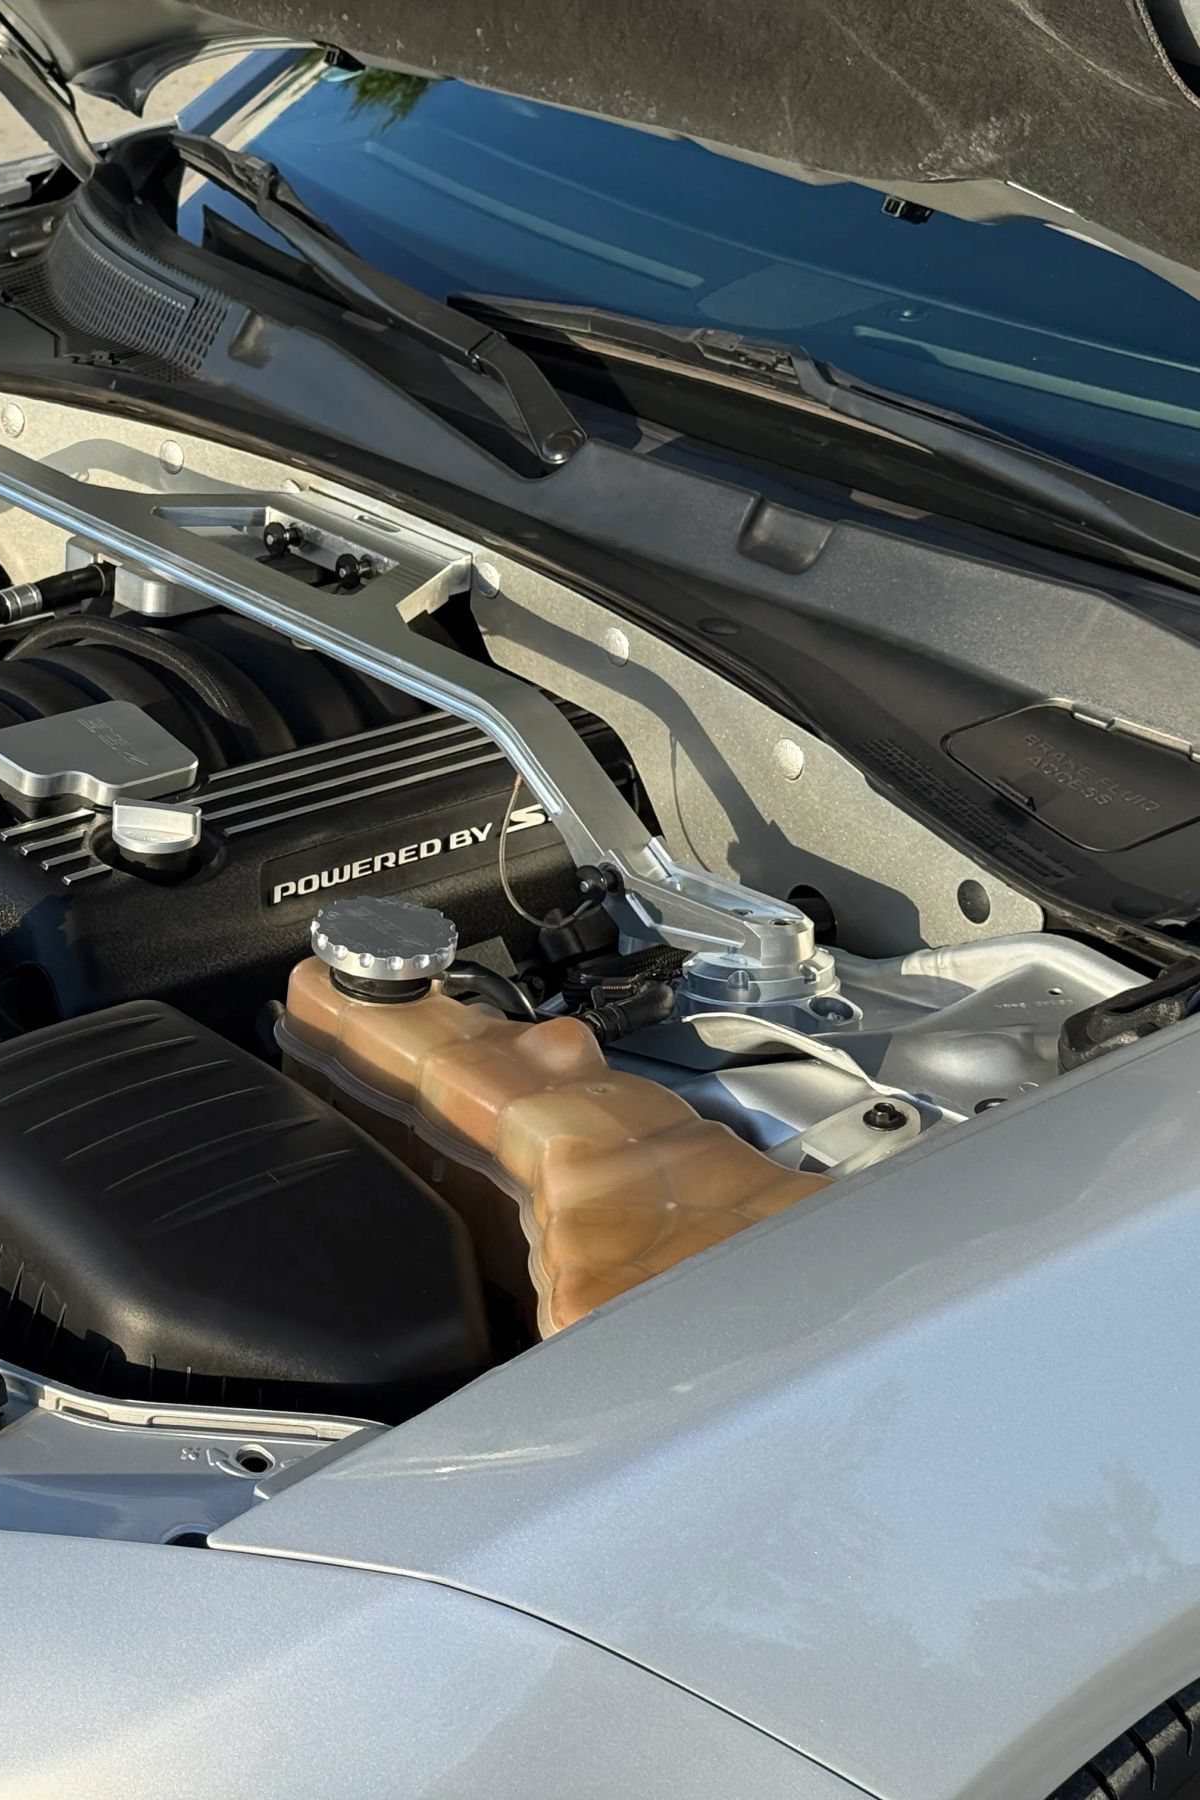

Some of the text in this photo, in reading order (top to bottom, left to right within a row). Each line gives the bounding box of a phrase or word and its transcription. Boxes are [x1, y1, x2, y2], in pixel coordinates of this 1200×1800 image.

[1023, 733, 1161, 812] BRAKE FLUID
[1027, 755, 1114, 806] ACCESS
[271, 838, 442, 905] POWERED
[449, 822, 493, 851] BY
